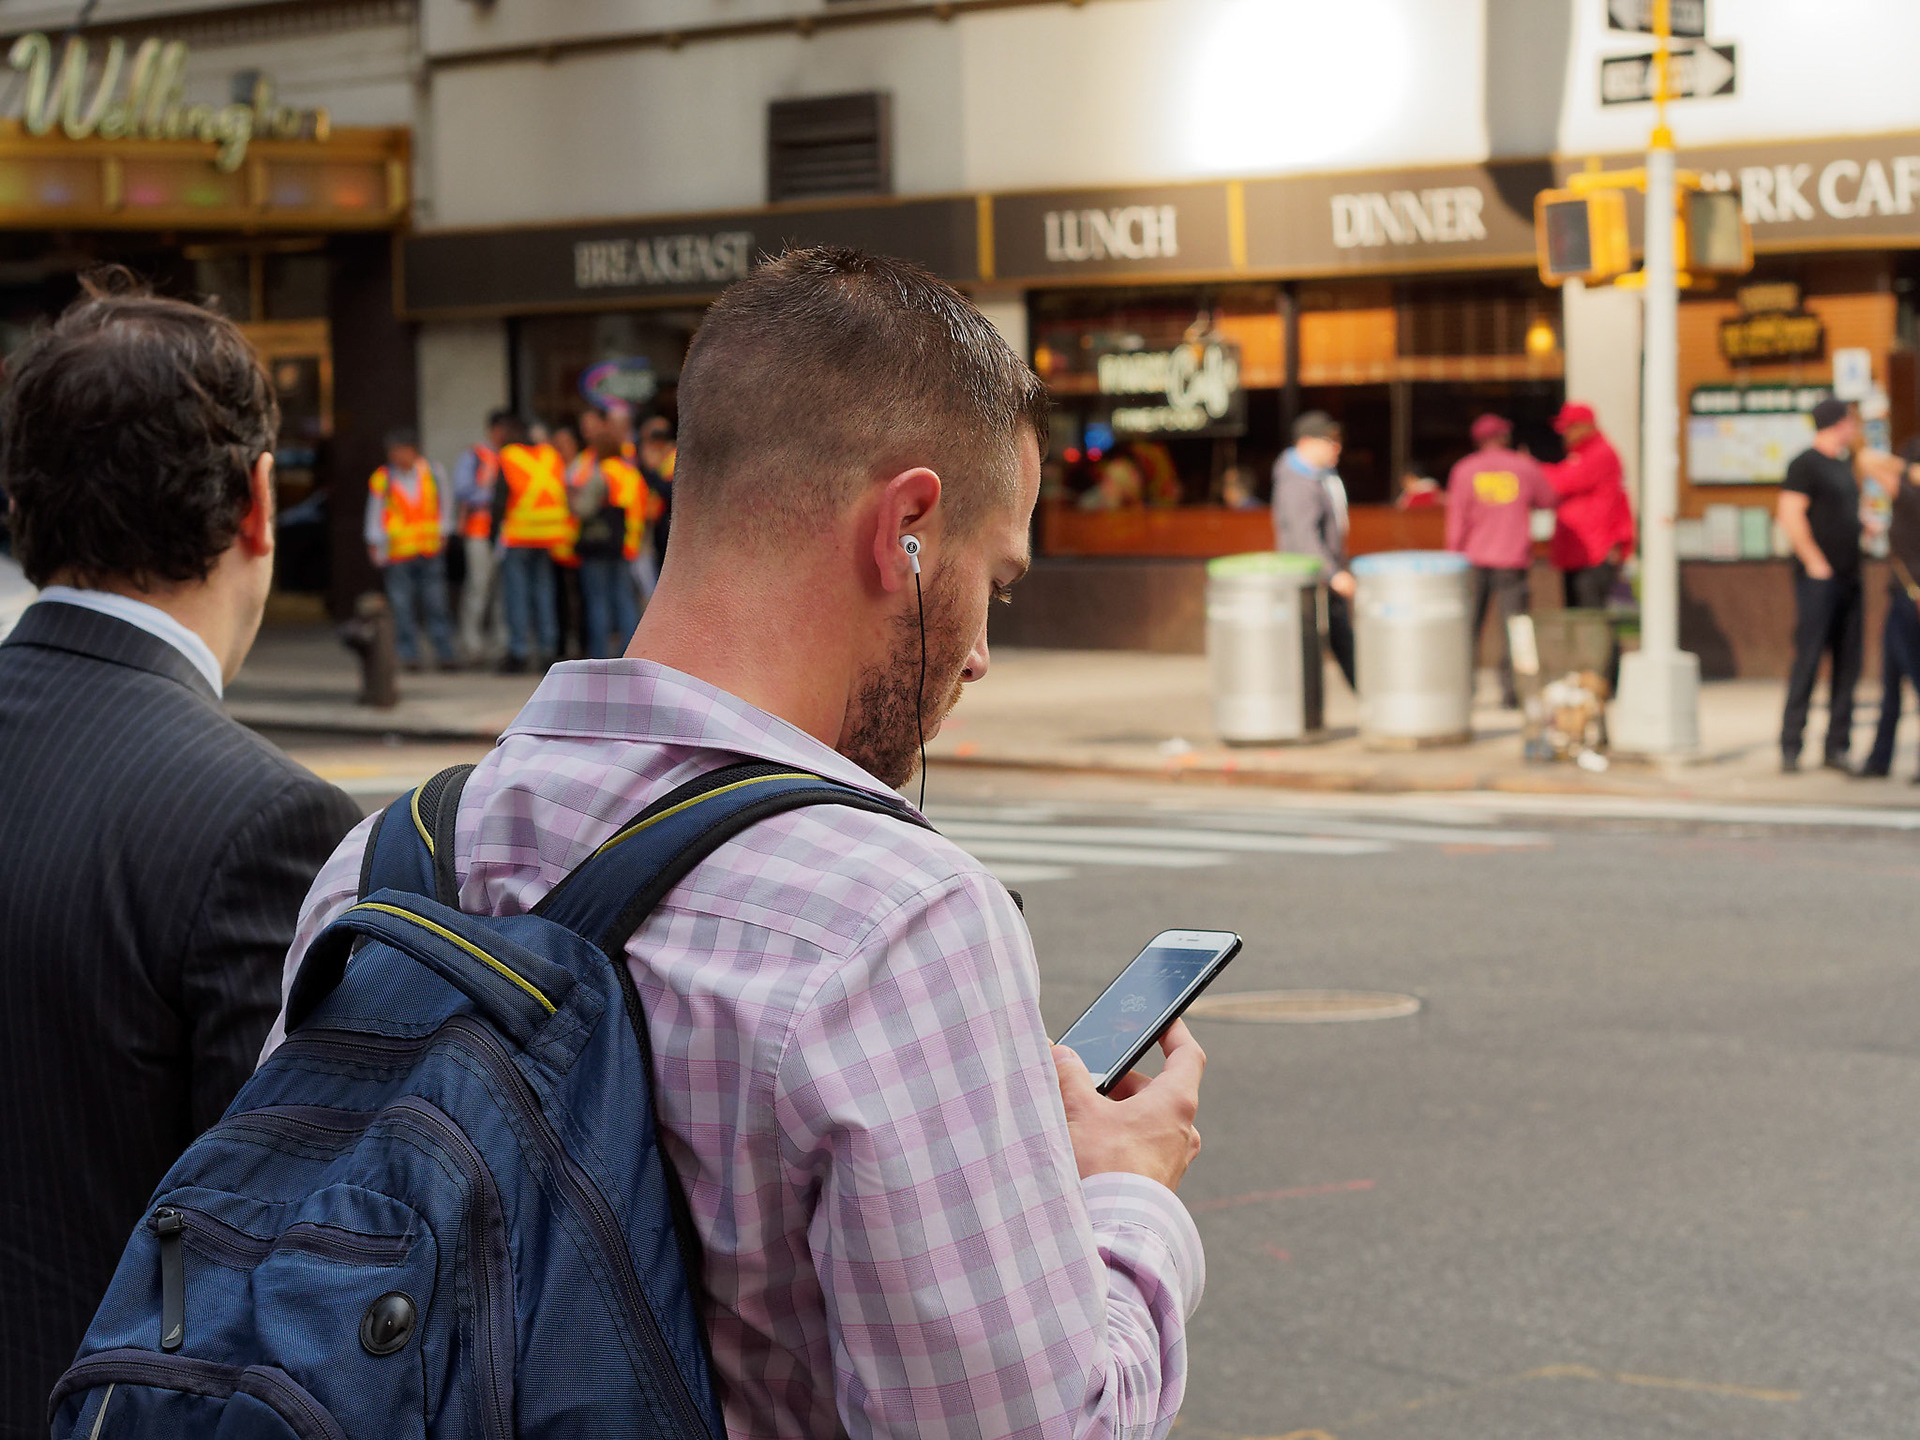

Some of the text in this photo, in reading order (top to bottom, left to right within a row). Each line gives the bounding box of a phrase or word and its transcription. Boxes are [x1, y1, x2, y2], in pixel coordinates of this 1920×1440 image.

[1044, 204, 1178, 261] LUNCH
[1330, 186, 1487, 248] DINNER
[574, 231, 752, 288] BREAKFAST
